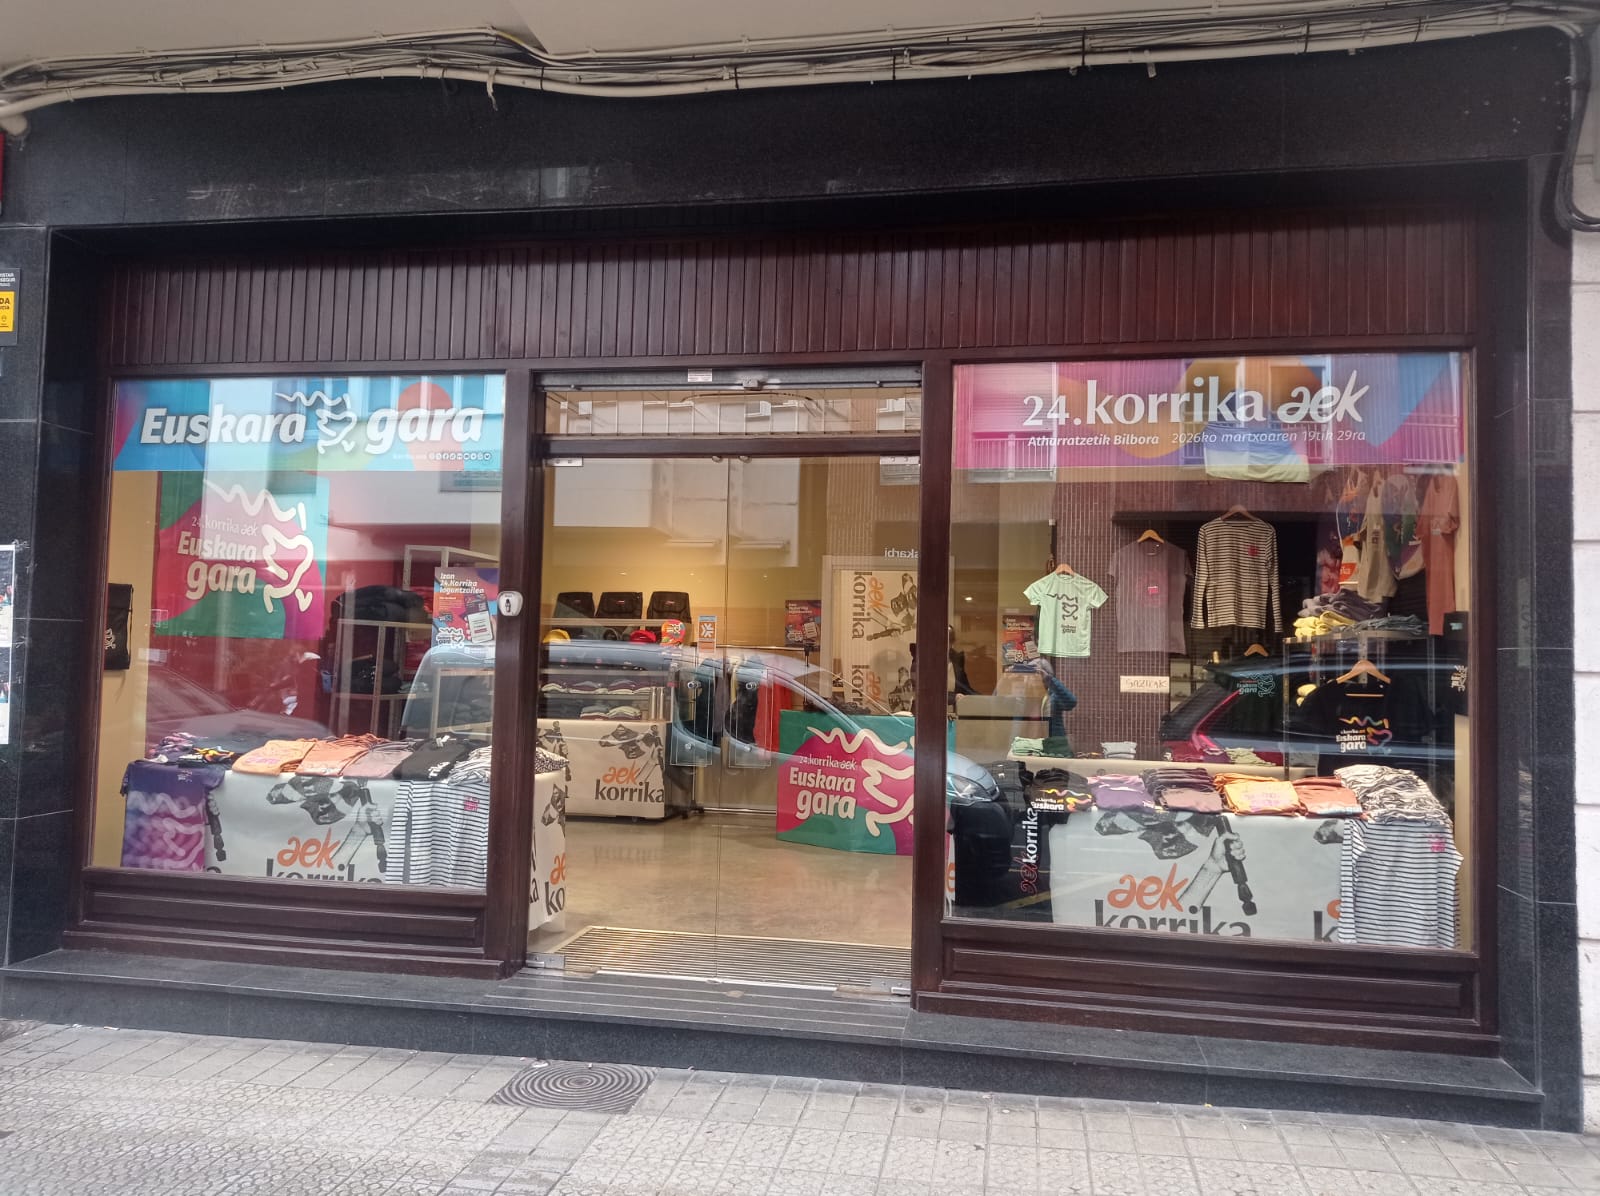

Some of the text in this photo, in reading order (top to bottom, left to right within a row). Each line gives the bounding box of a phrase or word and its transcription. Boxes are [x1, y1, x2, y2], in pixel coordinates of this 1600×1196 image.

[1277, 369, 1370, 424] aek
[140, 404, 484, 455] Euskara gara
[1028, 429, 1367, 447] Athurratzetik Bilbora 2026ko martxoaren 19tik 29ra
[177, 530, 257, 563] Euskara
[185, 560, 257, 600] gara
[869, 577, 890, 609] aek
[852, 572, 873, 640] korrika
[1340, 741, 1367, 753] gara
[602, 759, 641, 785] aek
[789, 766, 856, 793] Euskara
[595, 779, 665, 803] korrika
[795, 789, 857, 820] gara
[277, 826, 341, 870] aek
[1107, 863, 1189, 912] aek
